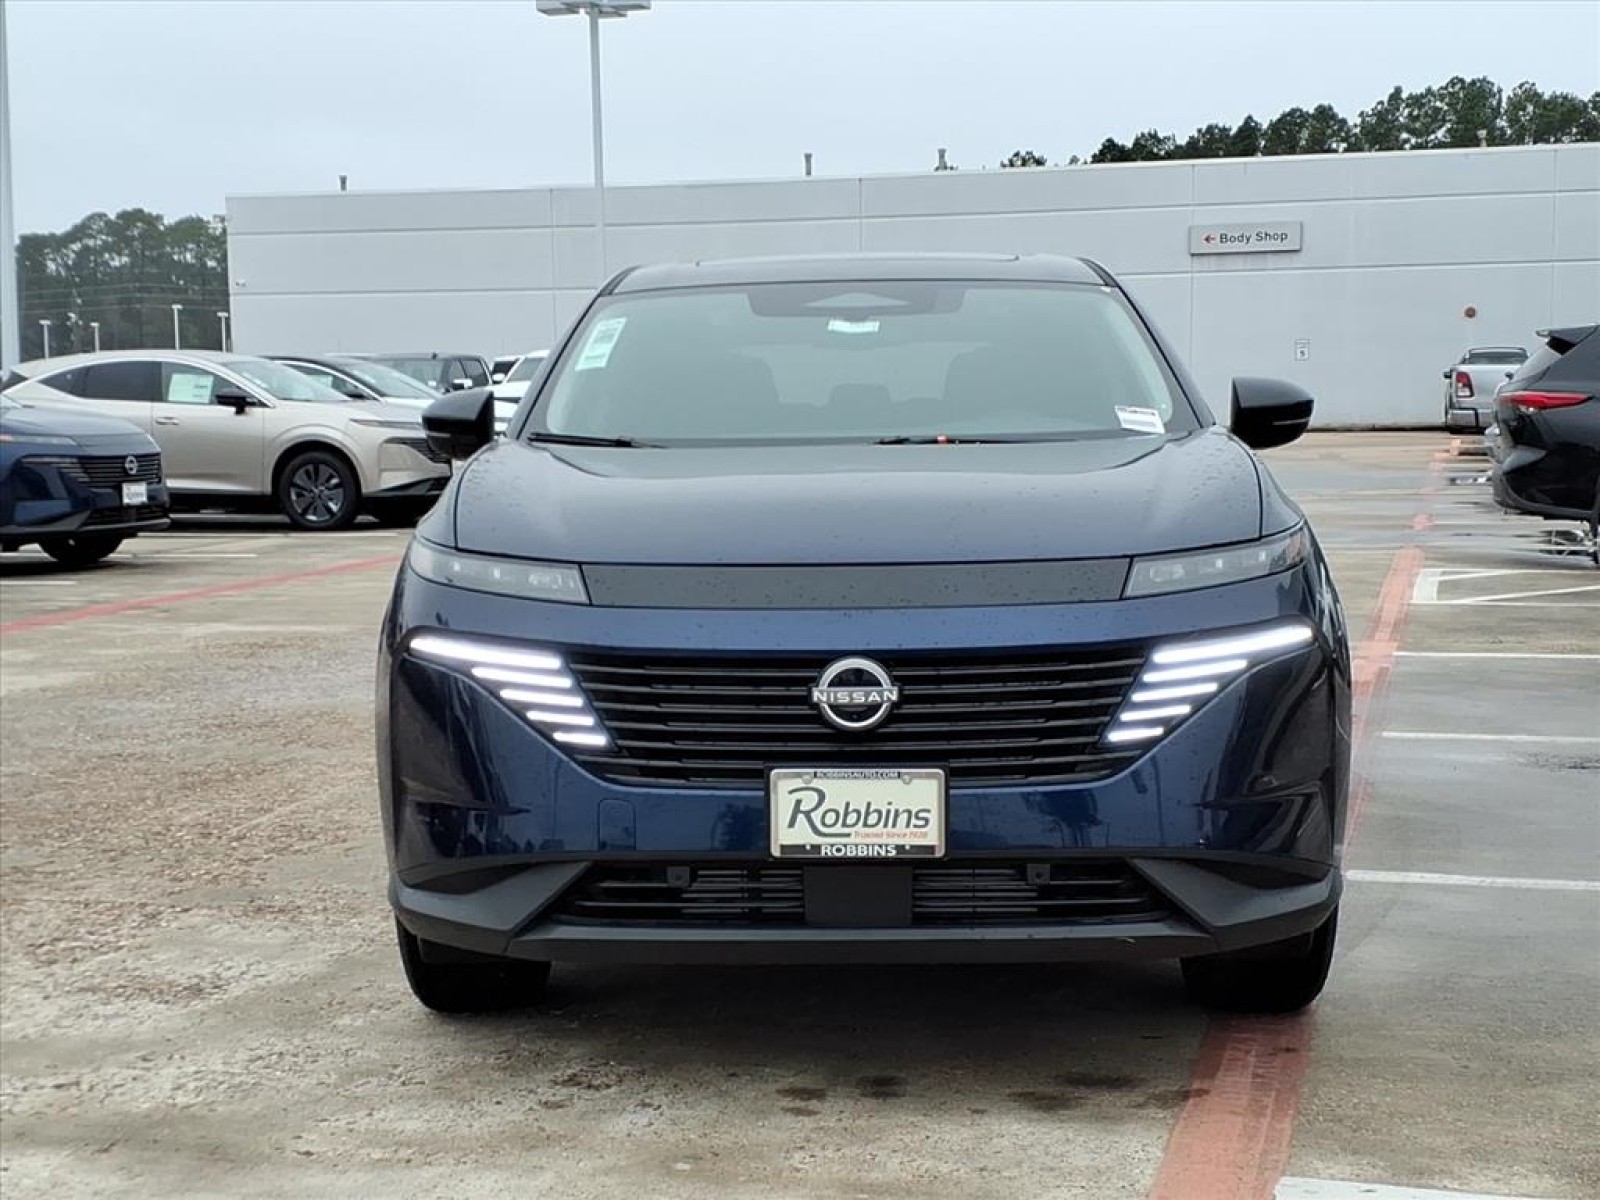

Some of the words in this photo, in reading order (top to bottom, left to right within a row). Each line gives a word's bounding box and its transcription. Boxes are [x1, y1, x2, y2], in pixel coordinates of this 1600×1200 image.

[1220, 233, 1251, 244] Body
[1255, 231, 1288, 243] Shop
[813, 690, 898, 703] NISSAN
[787, 786, 932, 839] Robbins
[820, 844, 898, 857] ROBBINS
